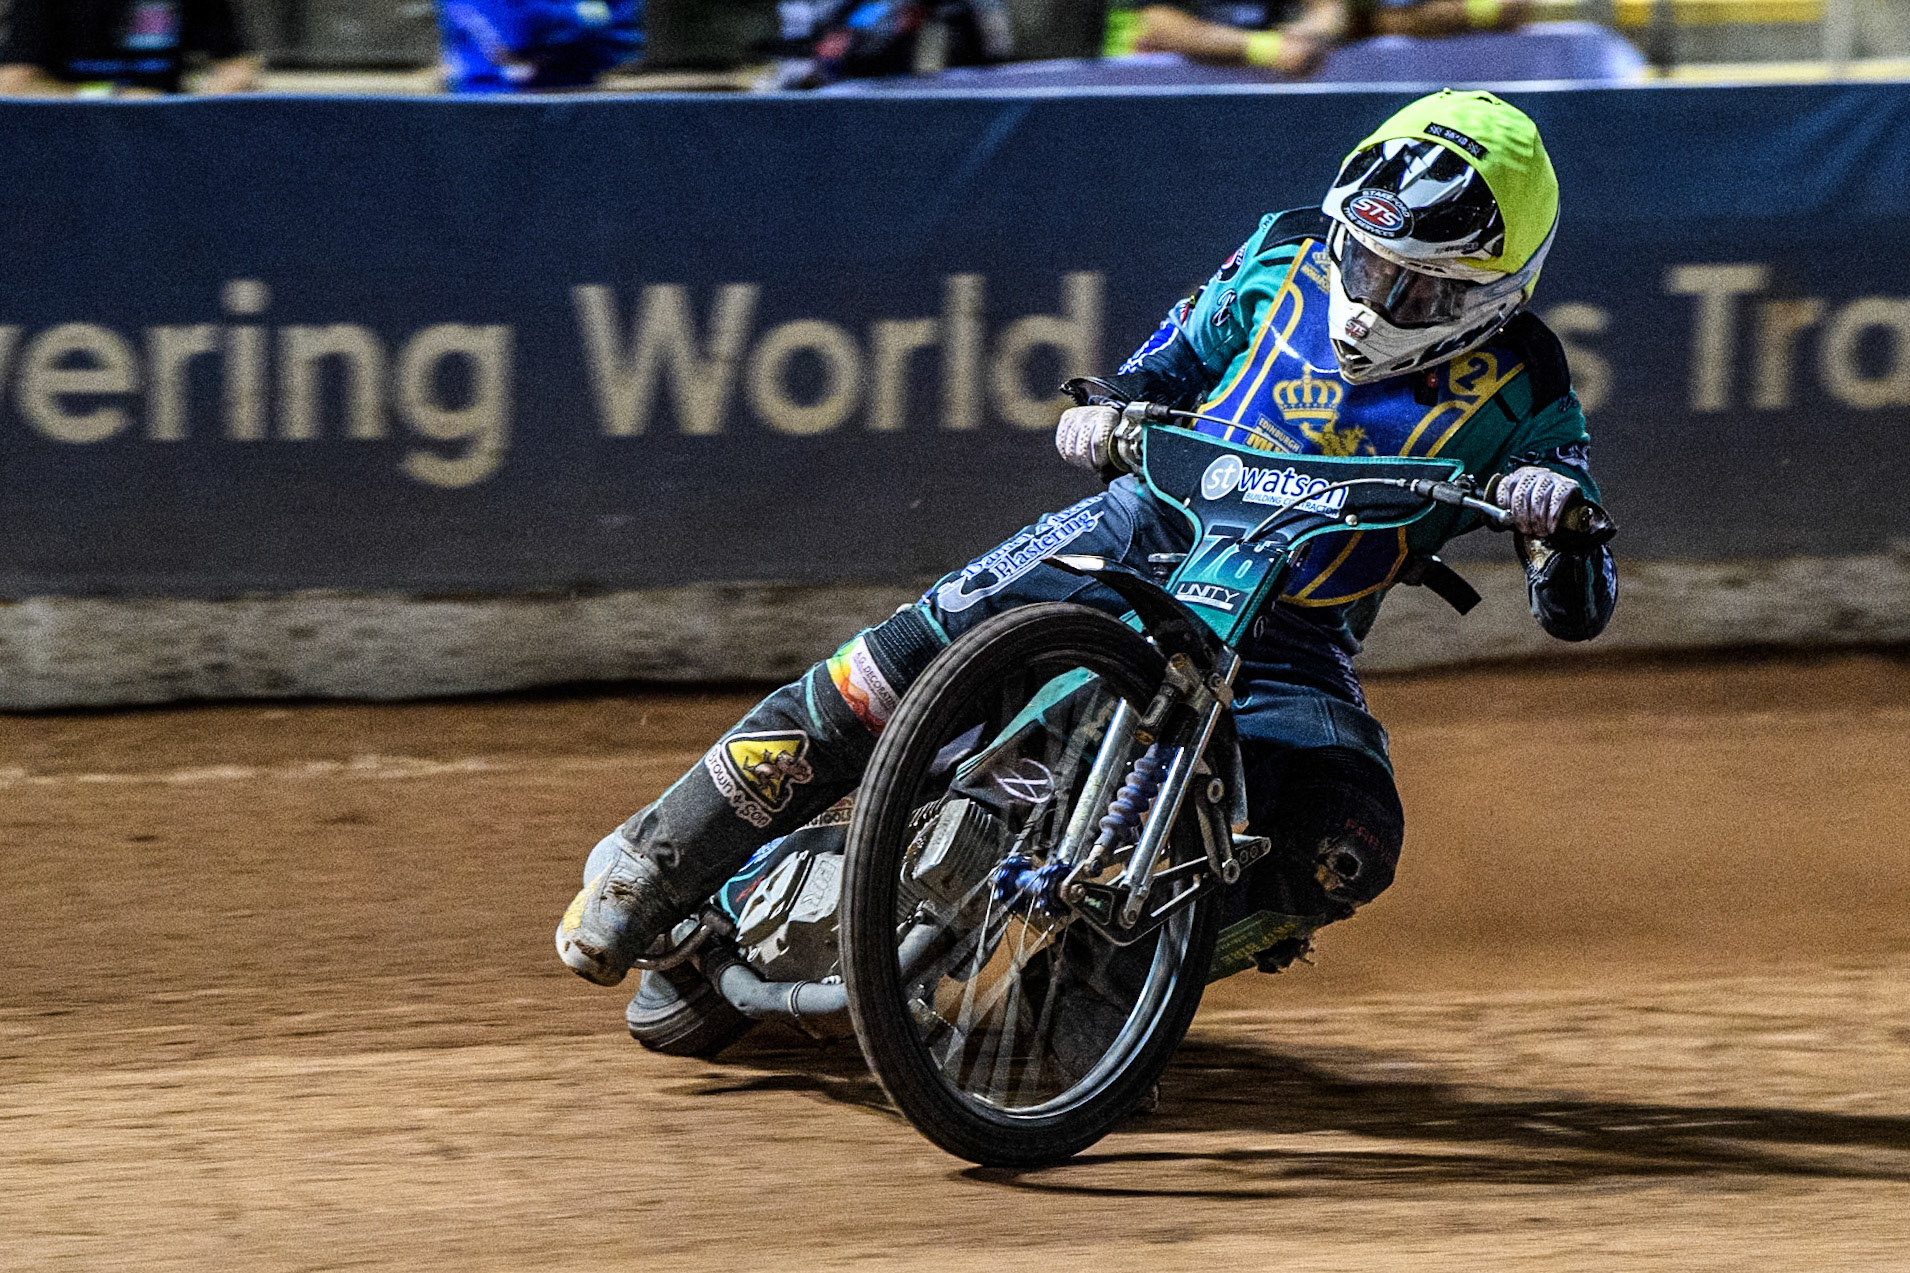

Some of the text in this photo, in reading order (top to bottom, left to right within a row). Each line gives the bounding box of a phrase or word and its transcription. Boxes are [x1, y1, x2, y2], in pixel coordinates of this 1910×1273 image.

[1352, 199, 1402, 227] STS
[1345, 320, 1366, 337] STS
[572, 270, 1107, 436] World
[1258, 417, 1301, 452] EDINBURGH
[1206, 463, 1348, 507] st watson
[1244, 492, 1340, 517] BUILDING COTRACTOR
[990, 511, 1095, 582] Plastering
[1177, 583, 1241, 604] UNITY
[708, 748, 733, 794] Brown
[741, 803, 770, 826] Son
